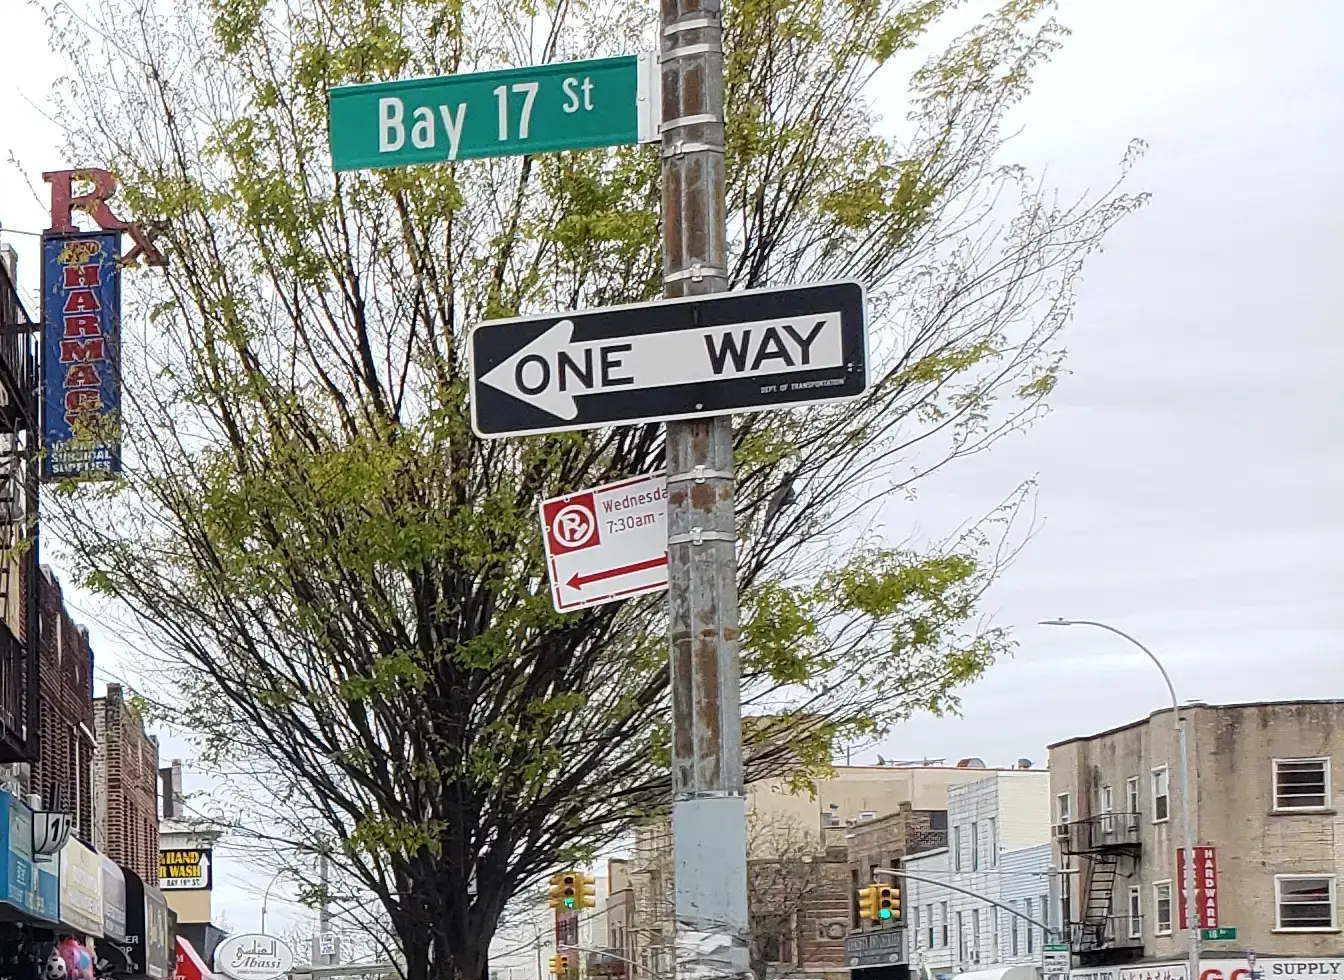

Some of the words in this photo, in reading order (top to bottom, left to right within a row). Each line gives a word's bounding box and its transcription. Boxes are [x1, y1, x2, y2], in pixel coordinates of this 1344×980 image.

[378, 97, 467, 160] Bay
[494, 82, 539, 142] 17
[562, 76, 594, 114] St
[514, 343, 635, 396] ONE
[704, 320, 827, 375] WAY
[791, 378, 845, 390] TRANSPORTATION
[603, 487, 668, 513] Wednesda
[607, 512, 656, 534] 7:30am
[166, 852, 199, 864] HAND
[169, 865, 201, 877] WASH
[1204, 849, 1216, 927] HARDWARE
[231, 957, 282, 969] Abassi
[1273, 962, 1341, 975] SUPPLY
